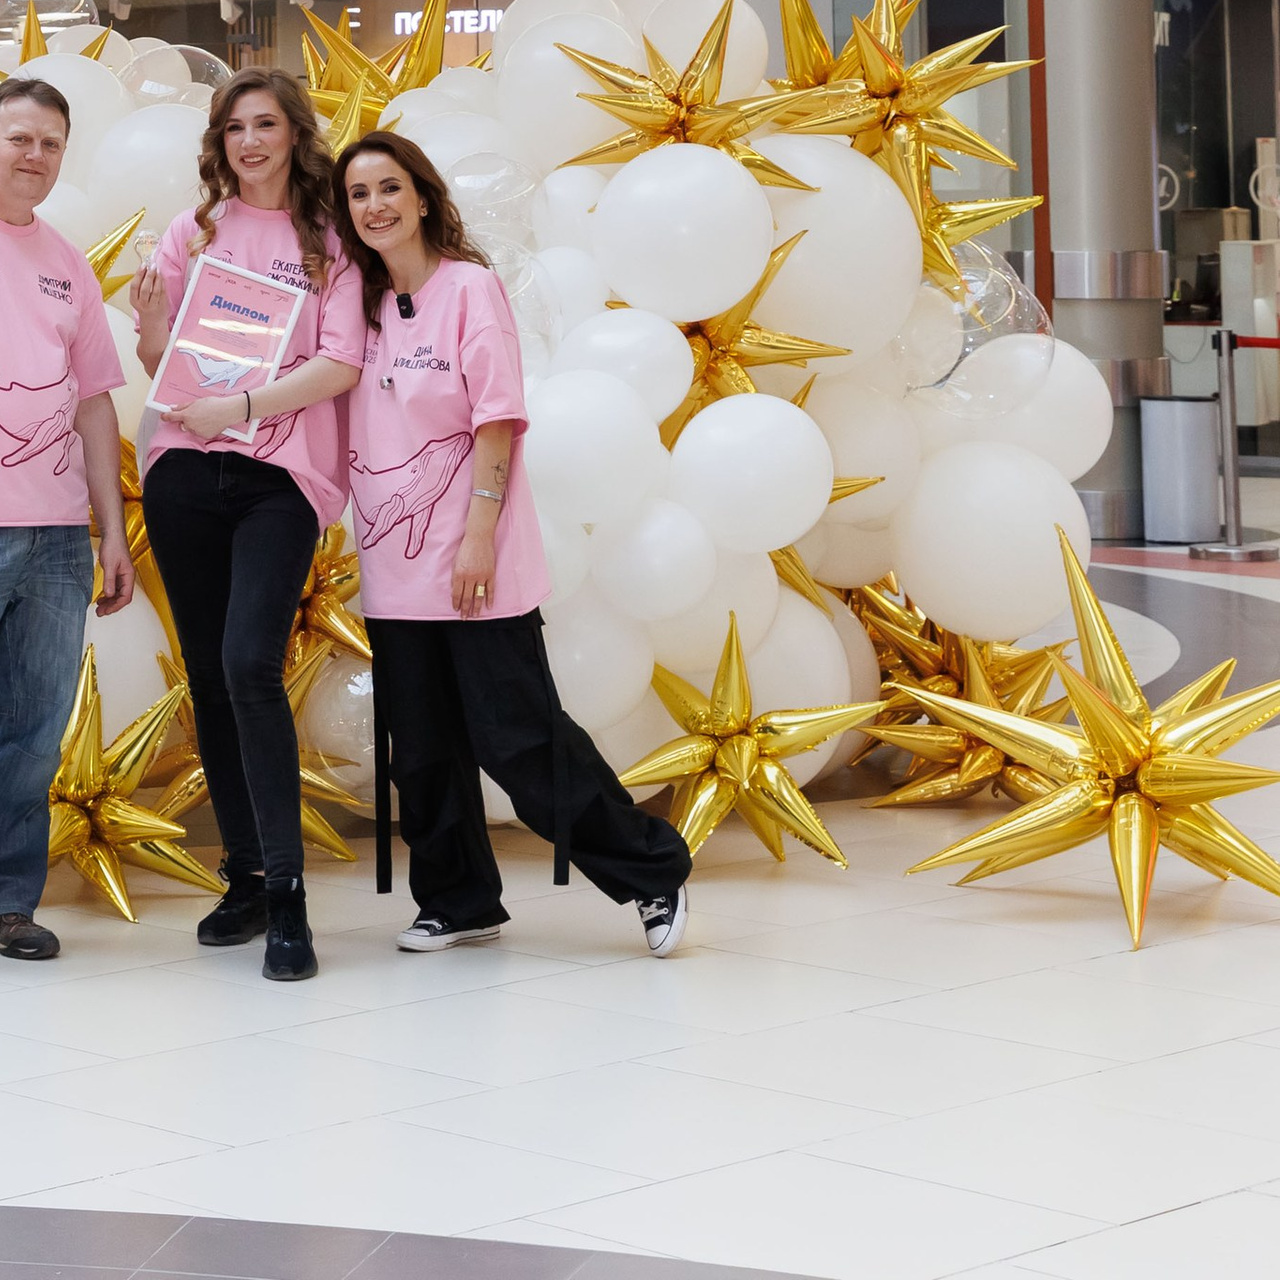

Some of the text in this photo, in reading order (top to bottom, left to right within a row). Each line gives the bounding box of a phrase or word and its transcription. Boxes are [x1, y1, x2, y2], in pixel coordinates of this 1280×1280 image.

[395, 9, 503, 35] ПТЕЛ
[38, 274, 72, 292] ДМИТРИЙ
[210, 294, 270, 324] Диплом
